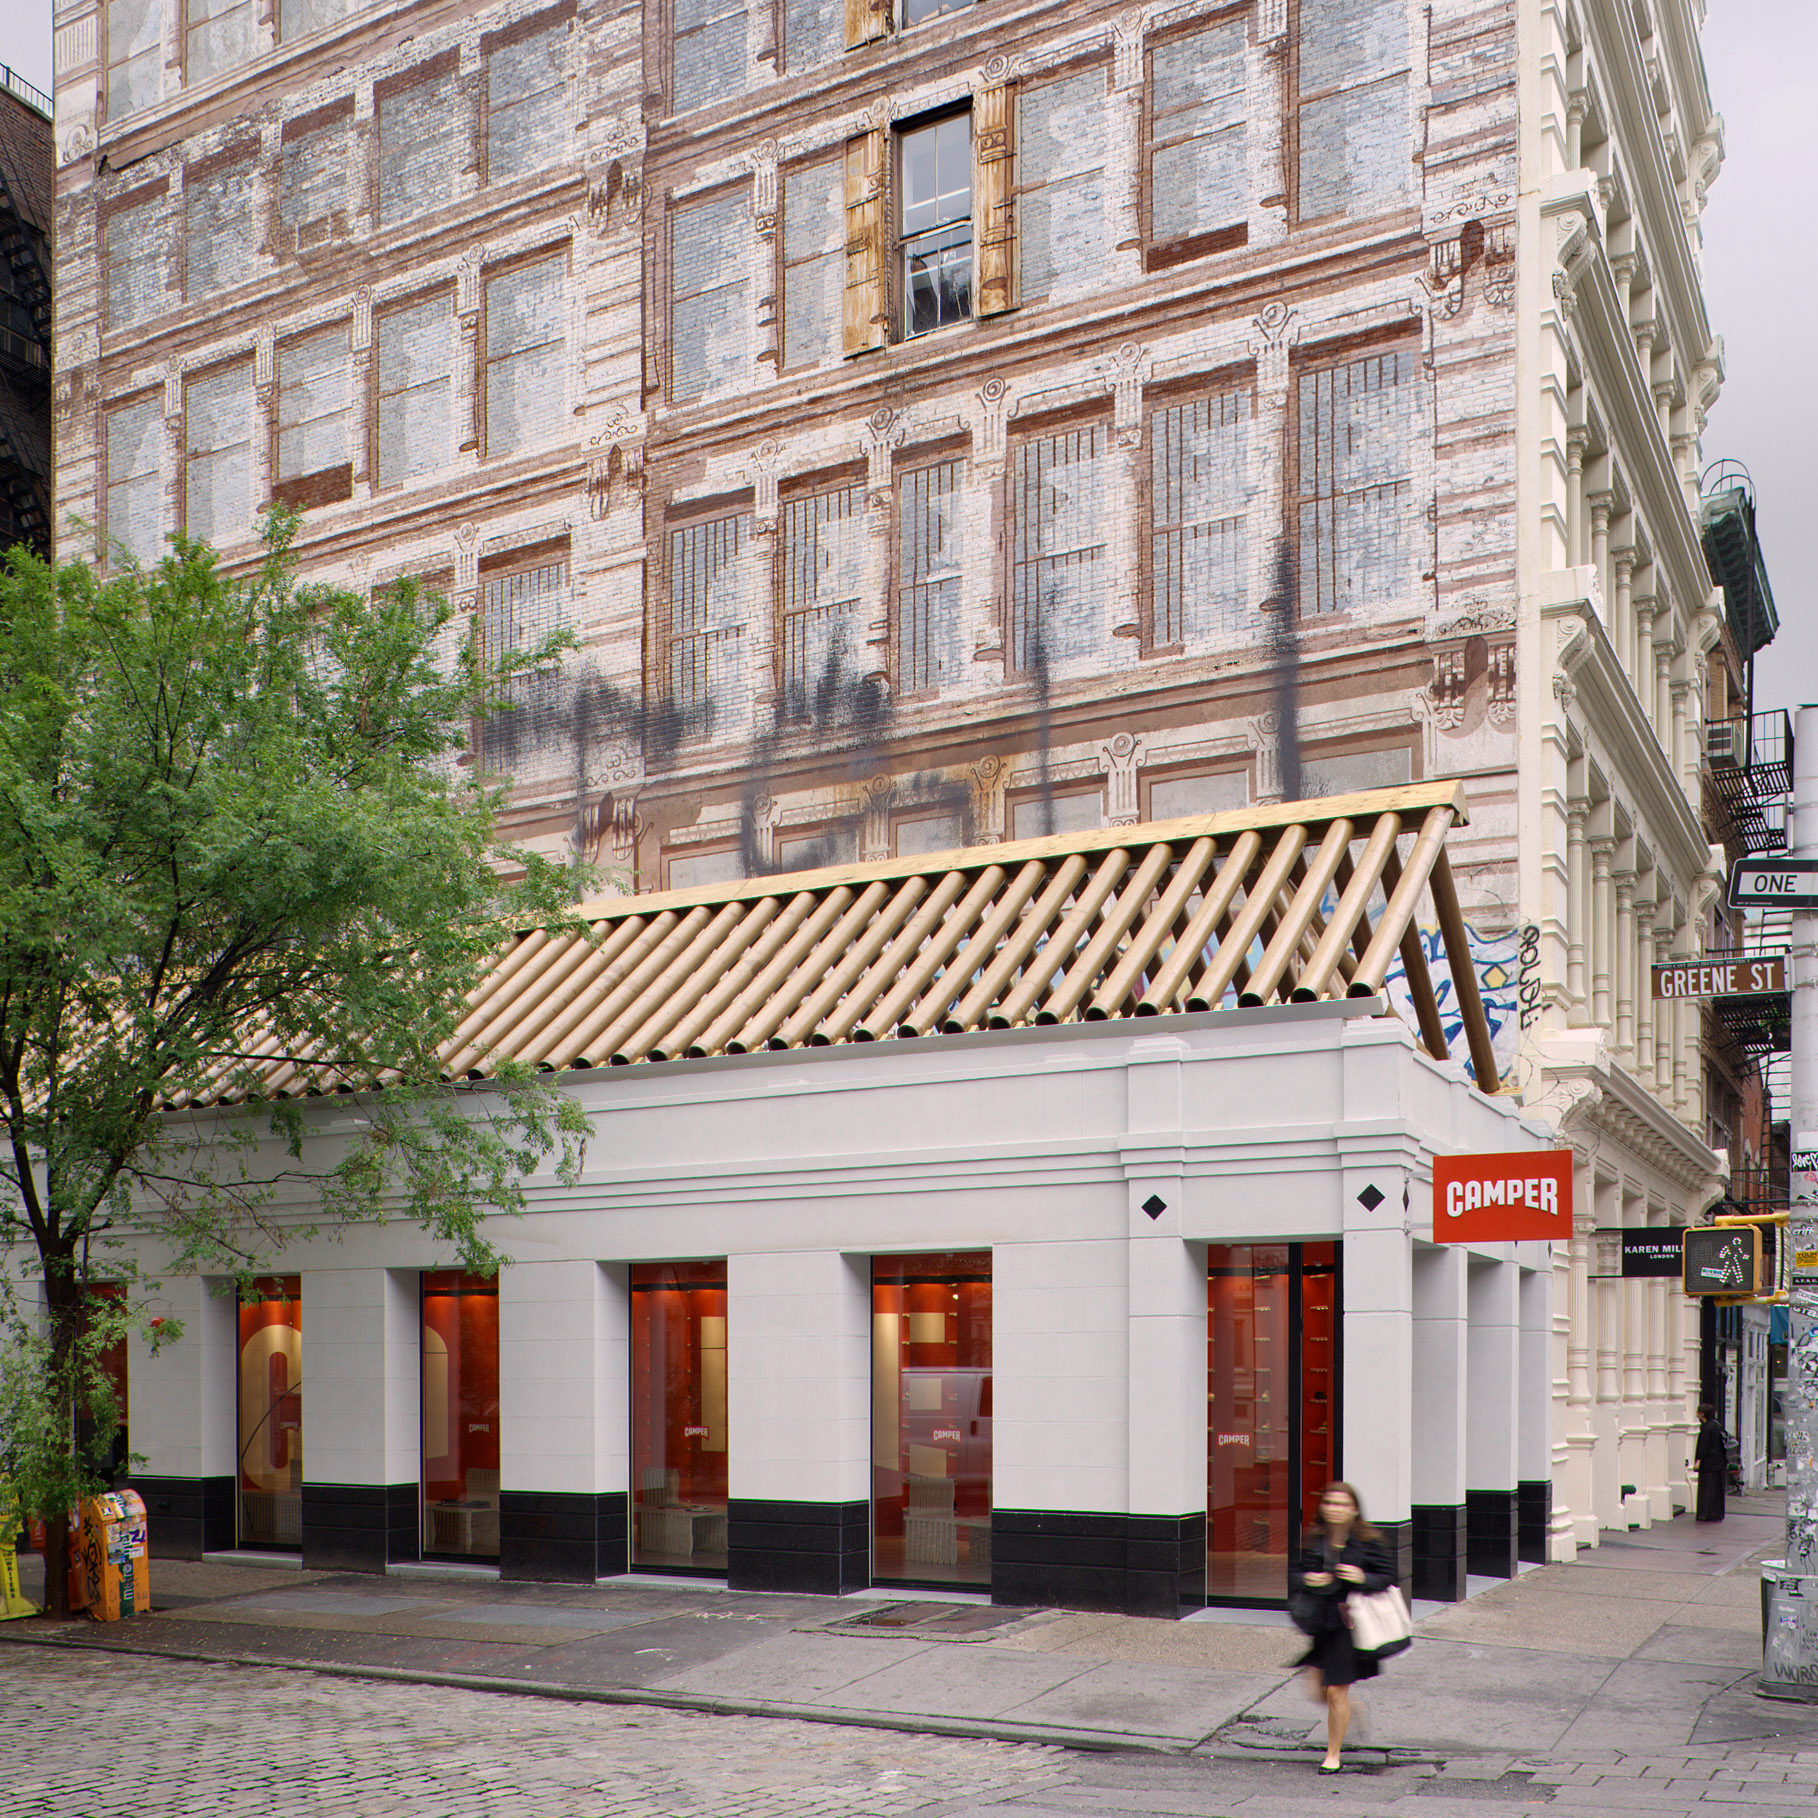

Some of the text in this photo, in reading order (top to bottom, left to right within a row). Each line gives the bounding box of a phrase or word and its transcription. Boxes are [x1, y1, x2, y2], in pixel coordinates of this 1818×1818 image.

[1754, 874, 1798, 893] ONE
[1660, 963, 1775, 997] GREENE ST
[1447, 1178, 1558, 1218] CAMPER
[1624, 1245, 1659, 1254] KAREN
[684, 1427, 709, 1438] CAMPER
[933, 1430, 960, 1442] CAMPER
[1218, 1434, 1250, 1447] CAMPER
